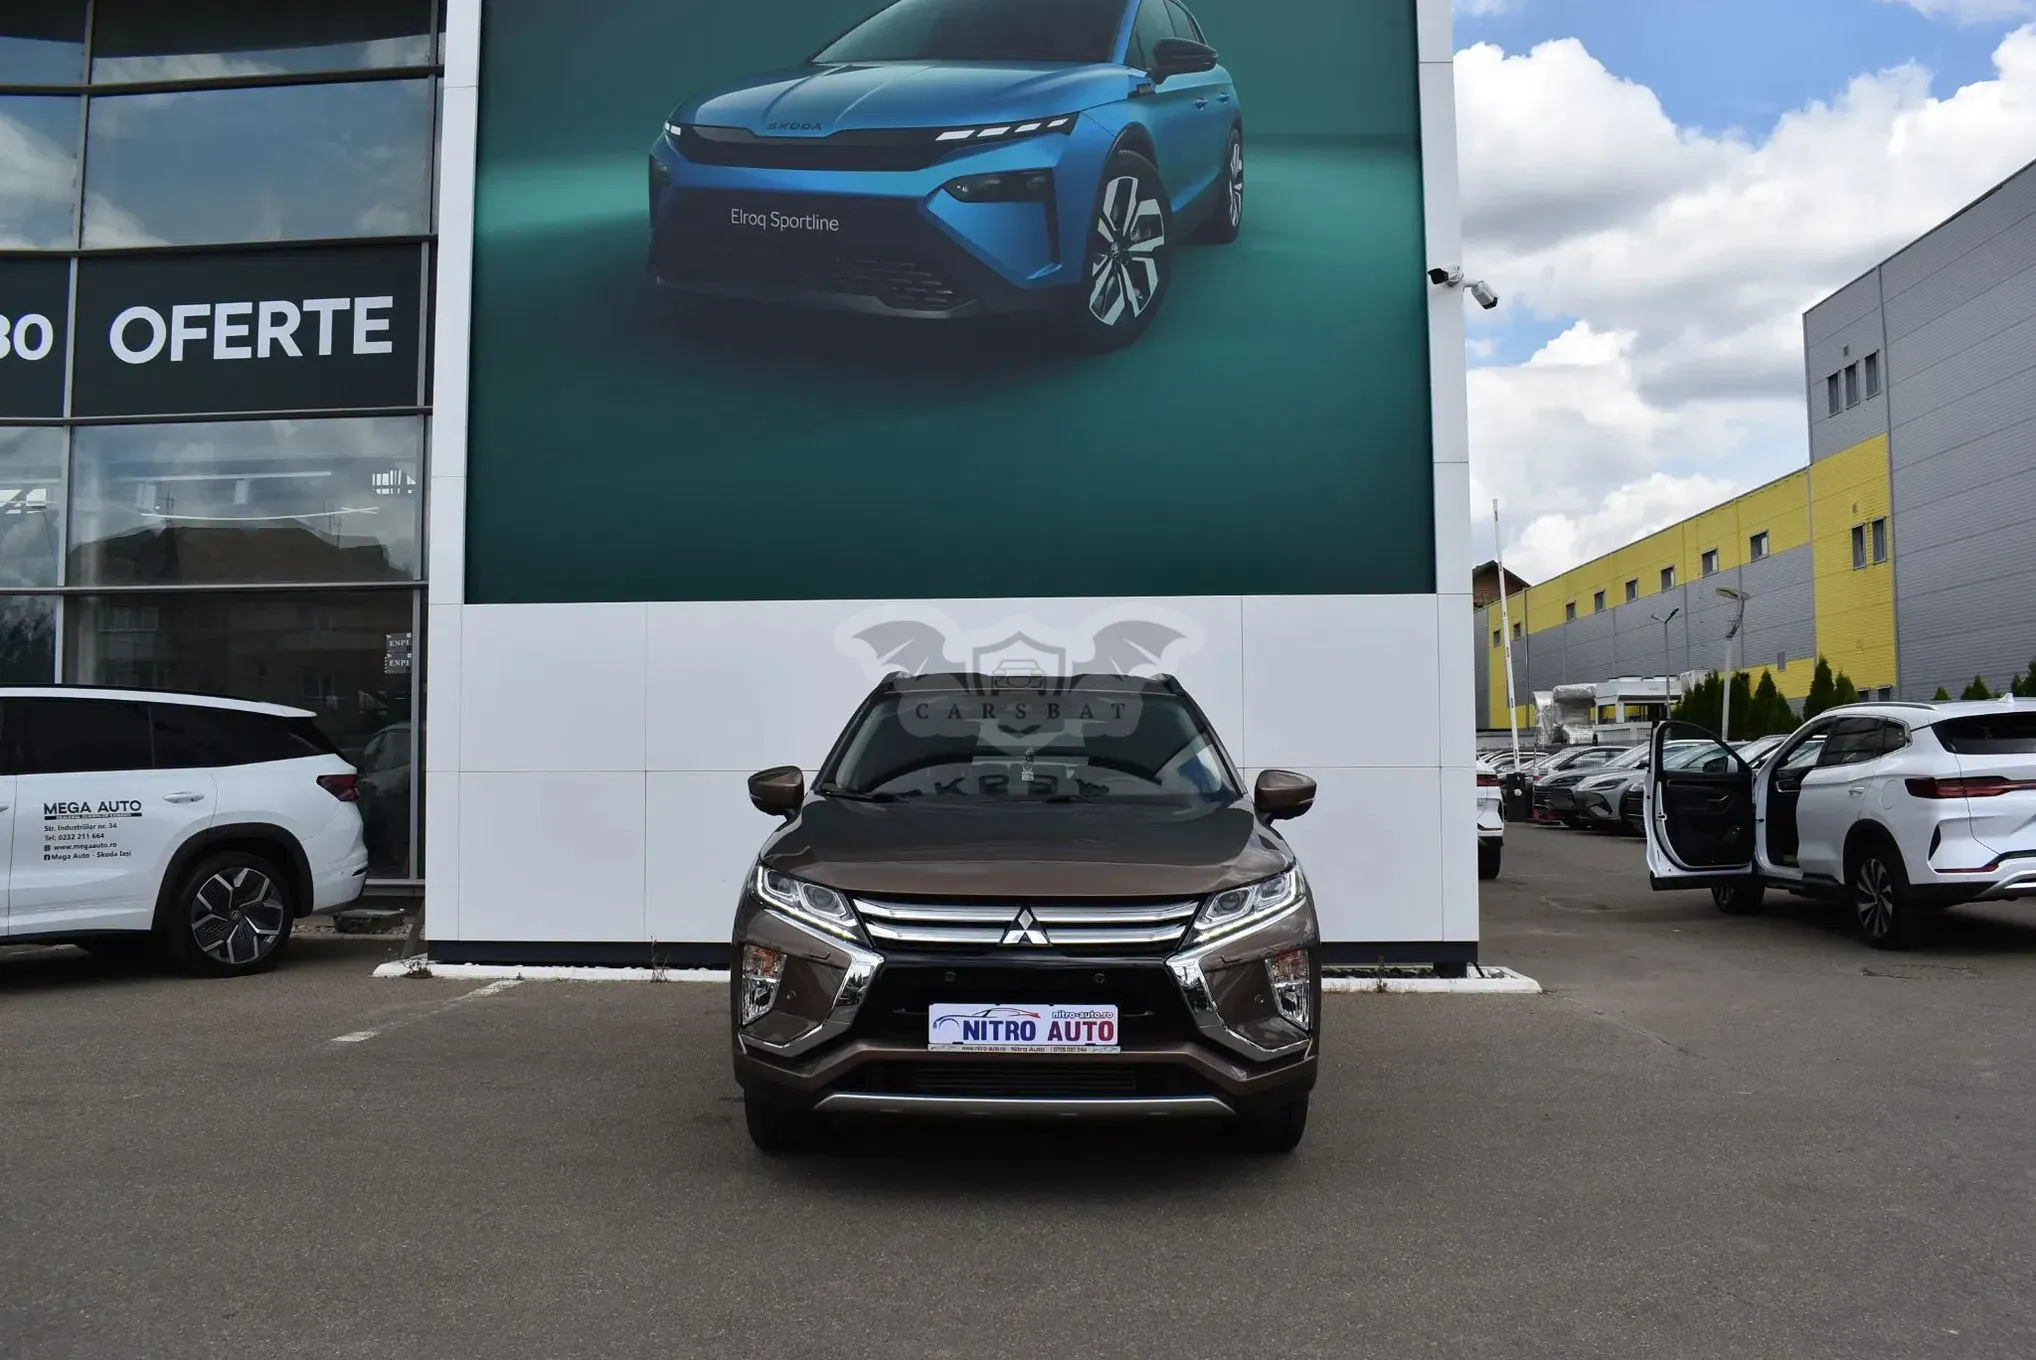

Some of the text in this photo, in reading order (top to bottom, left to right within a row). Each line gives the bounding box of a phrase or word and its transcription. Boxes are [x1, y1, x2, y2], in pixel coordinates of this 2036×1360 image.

[731, 208, 839, 231] Elroq Sportline
[0, 313, 53, 361] 0
[109, 295, 394, 364] OFERTE
[44, 800, 142, 815] MEGA AUTO
[44, 834, 56, 842] Tel:
[58, 833, 75, 841] 0232
[53, 842, 118, 851] www.megaauto.ro
[51, 853, 71, 862] Mega
[72, 852, 90, 860] Auto
[96, 850, 118, 858] Skoda
[1052, 1010, 1113, 1019] nitro-auto.ro
[962, 1020, 1115, 1042] NITRO AUTO
